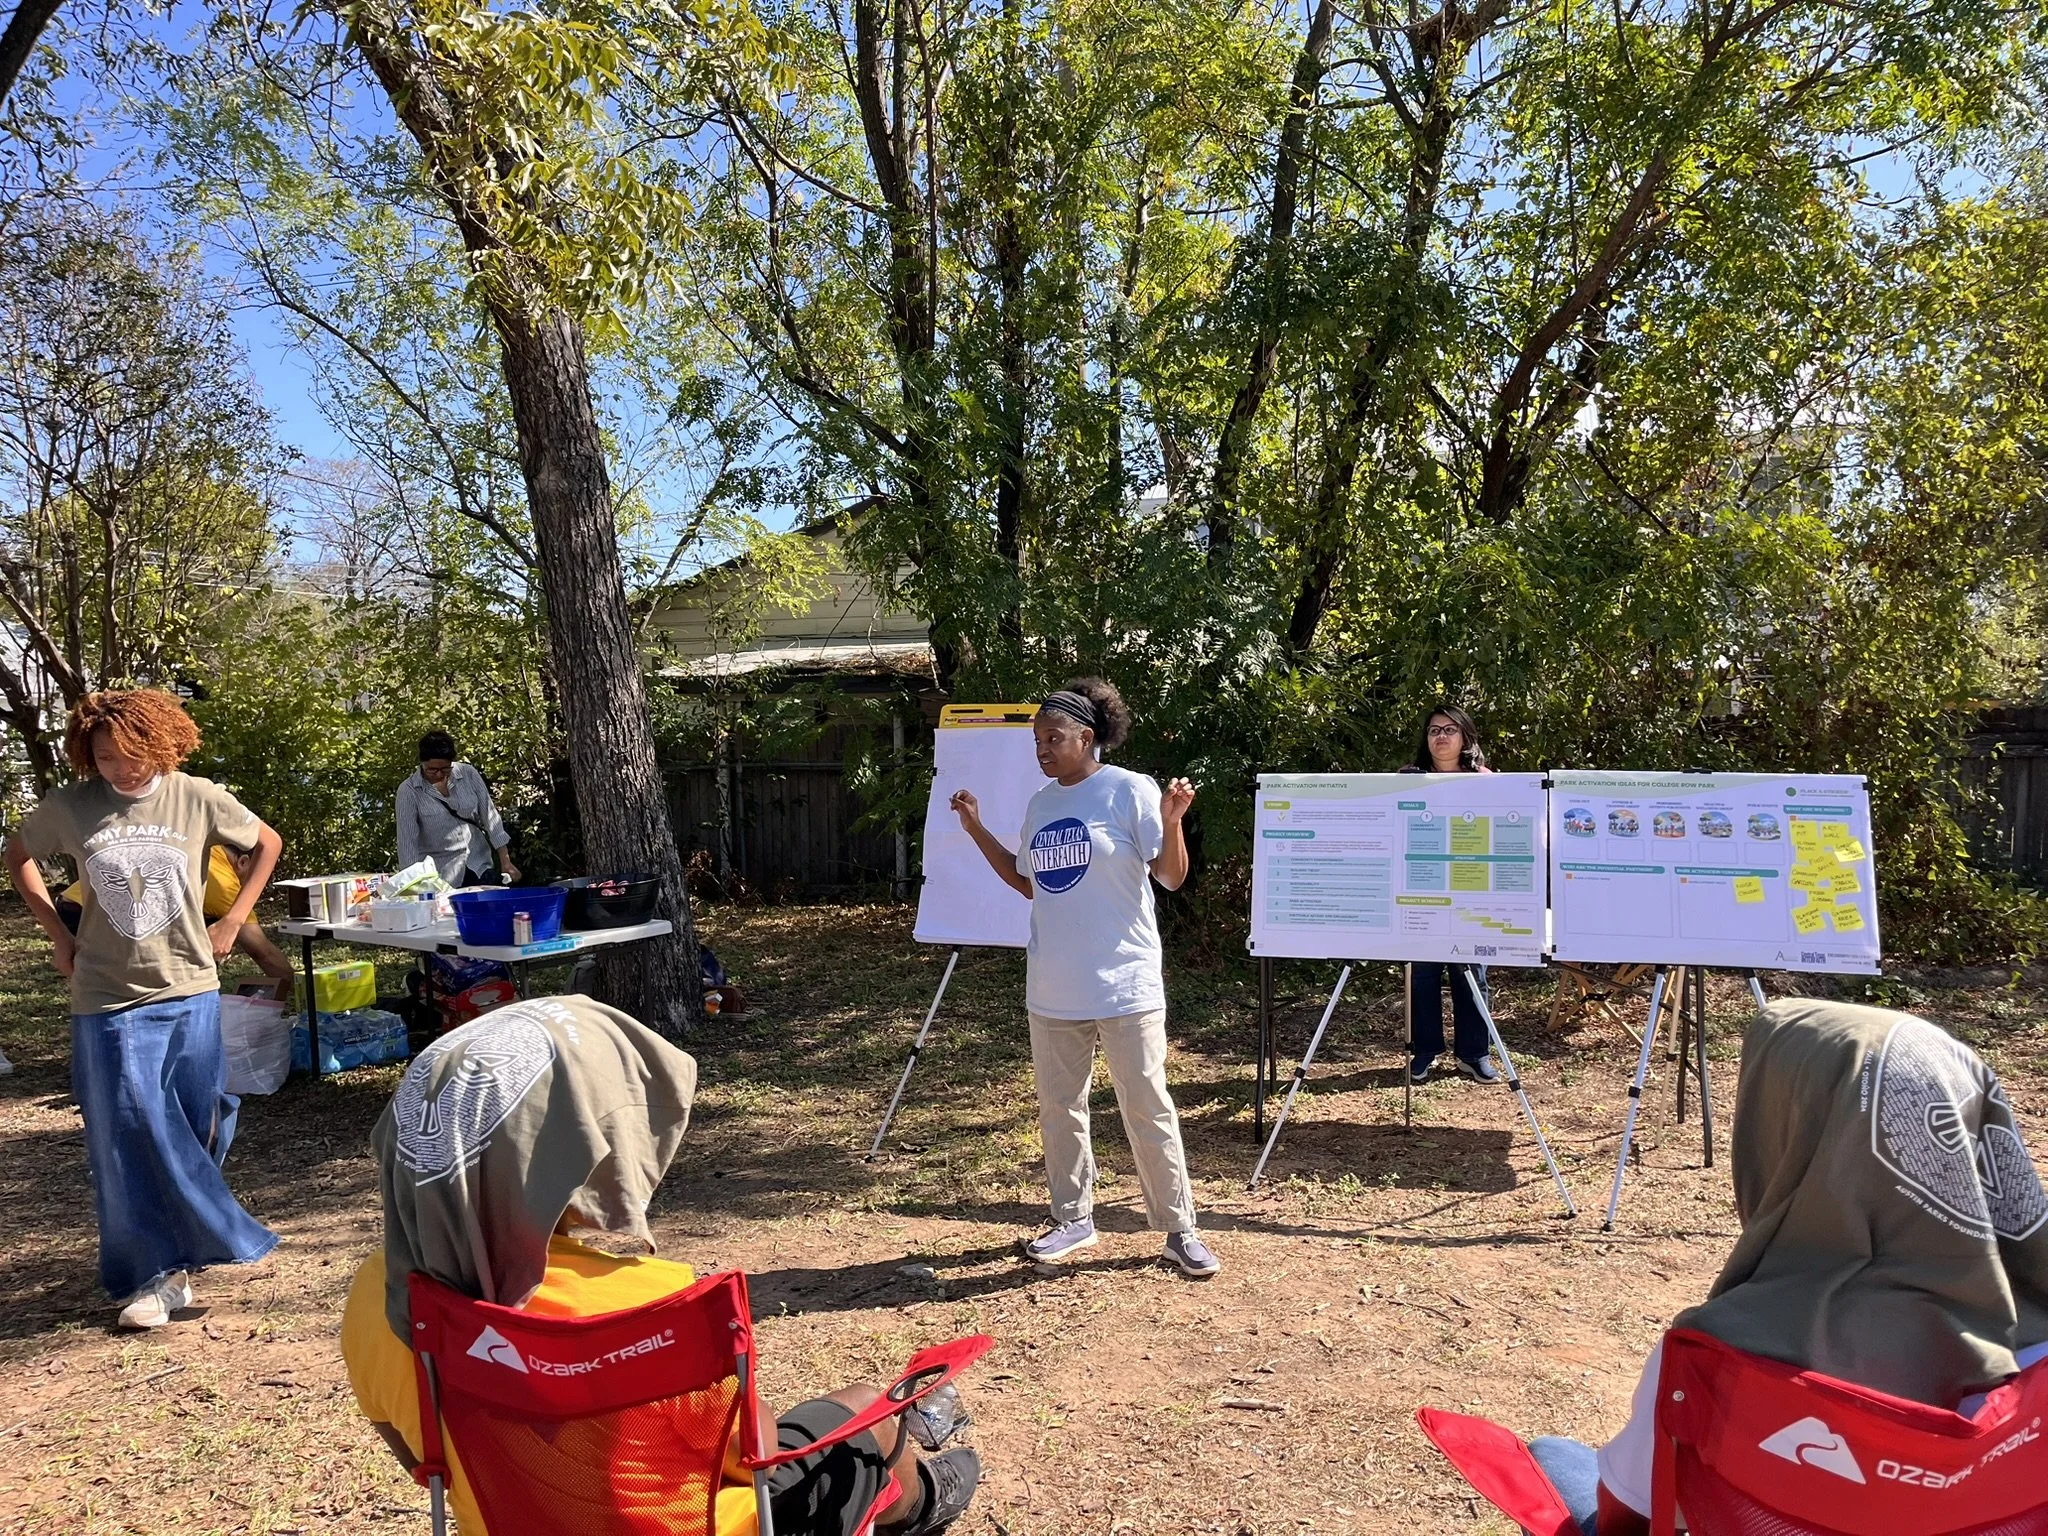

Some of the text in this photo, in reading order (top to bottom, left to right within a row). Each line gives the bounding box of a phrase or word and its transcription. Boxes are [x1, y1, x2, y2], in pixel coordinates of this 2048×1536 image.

[97, 826, 122, 844] MY
[126, 823, 172, 838] PARK
[172, 831, 188, 843] DAY
[1035, 825, 1085, 848] CENTRAL TEXAS
[1032, 842, 1088, 871] INTERFAITH
[1895, 1185, 1924, 1206] AUSTIN
[1922, 1202, 1950, 1224] PARKS
